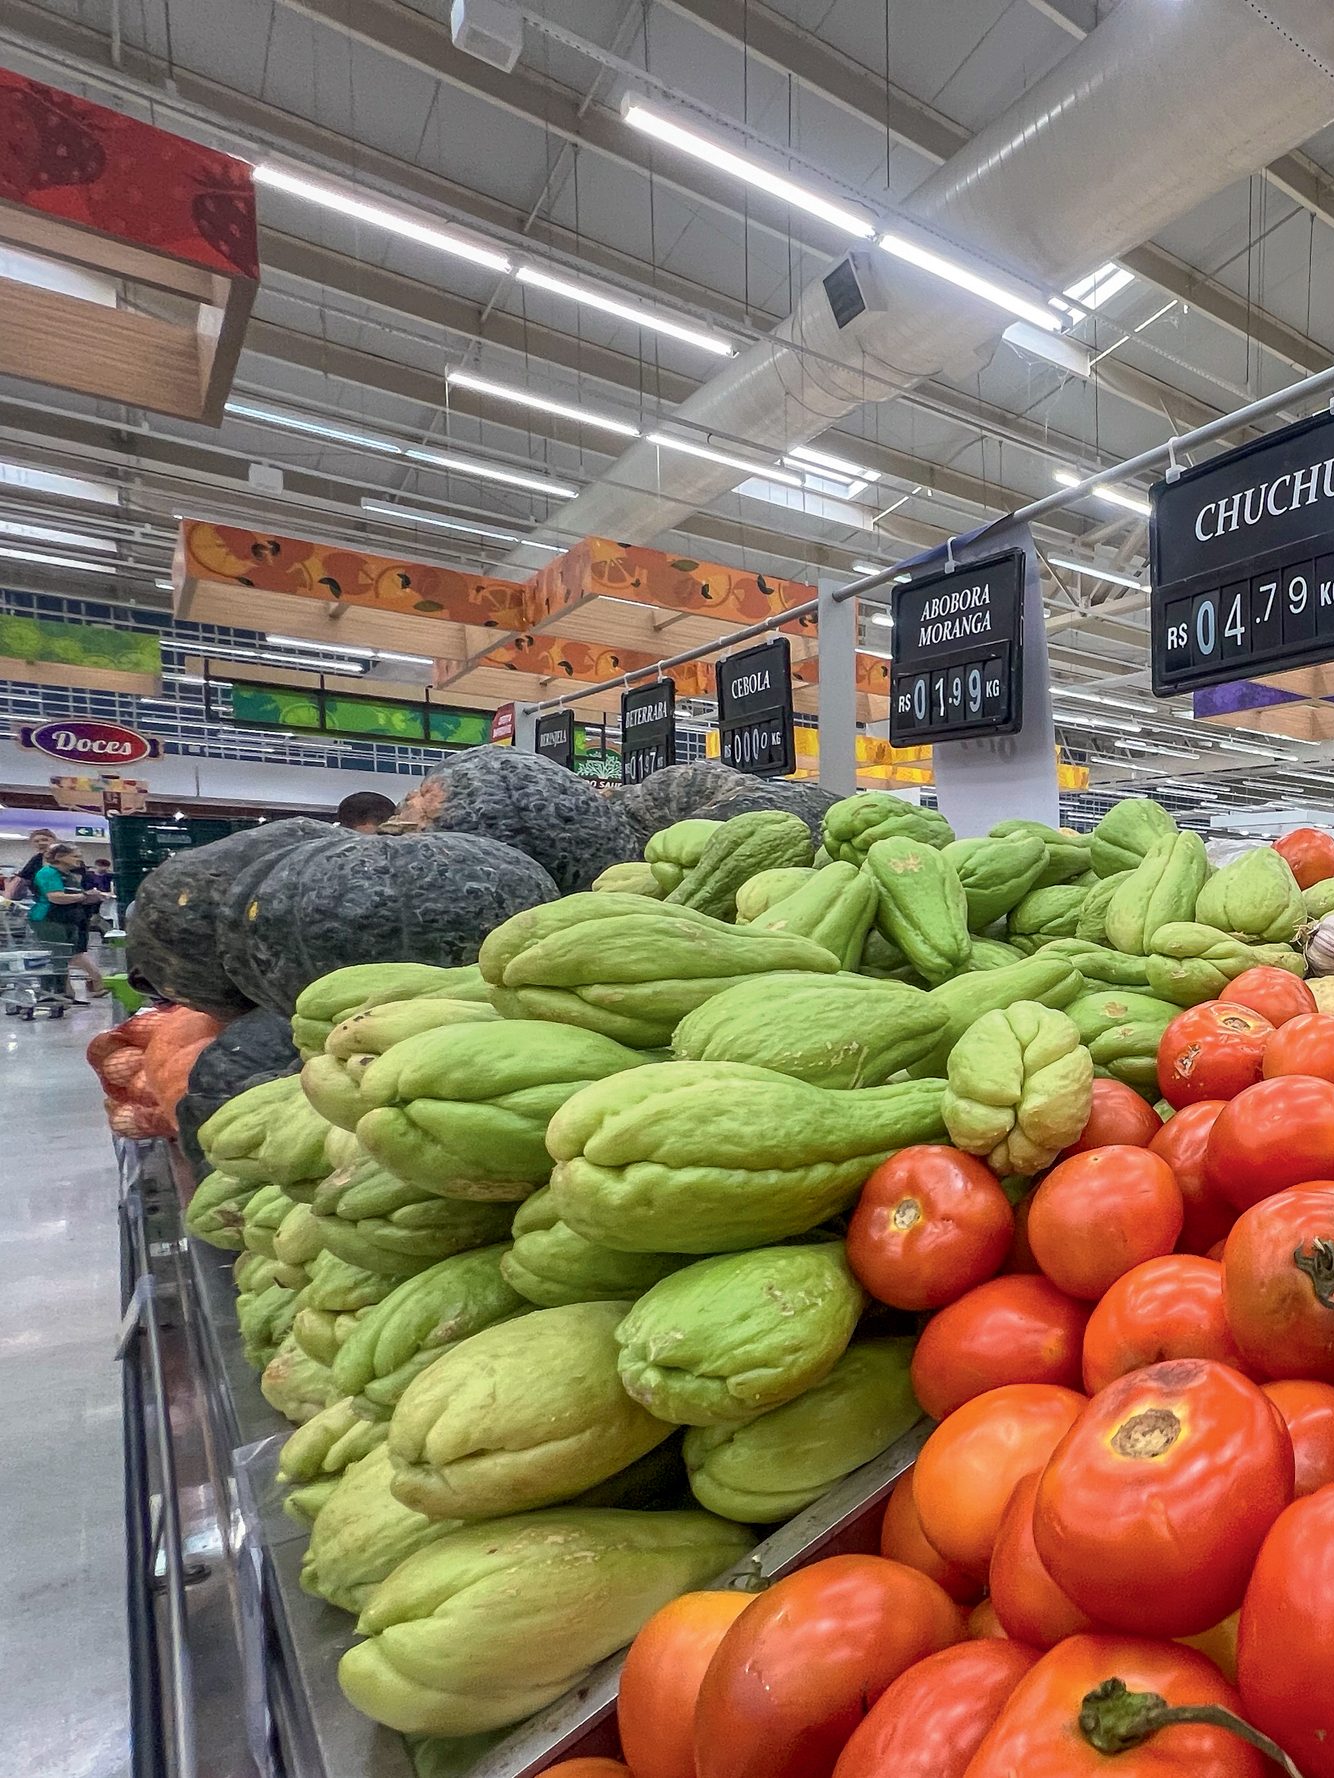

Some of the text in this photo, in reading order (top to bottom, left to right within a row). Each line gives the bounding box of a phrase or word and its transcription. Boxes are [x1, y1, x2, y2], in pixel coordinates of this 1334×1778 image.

[920, 583, 991, 622] ABOBORA
[918, 610, 992, 647] MORANGA
[1167, 622, 1188, 651] R$
[731, 669, 771, 699] CEBOLA
[985, 679, 1000, 698] KG
[625, 700, 668, 729] BETERRABA
[51, 730, 132, 756] Doces
[771, 731, 782, 746] KG
